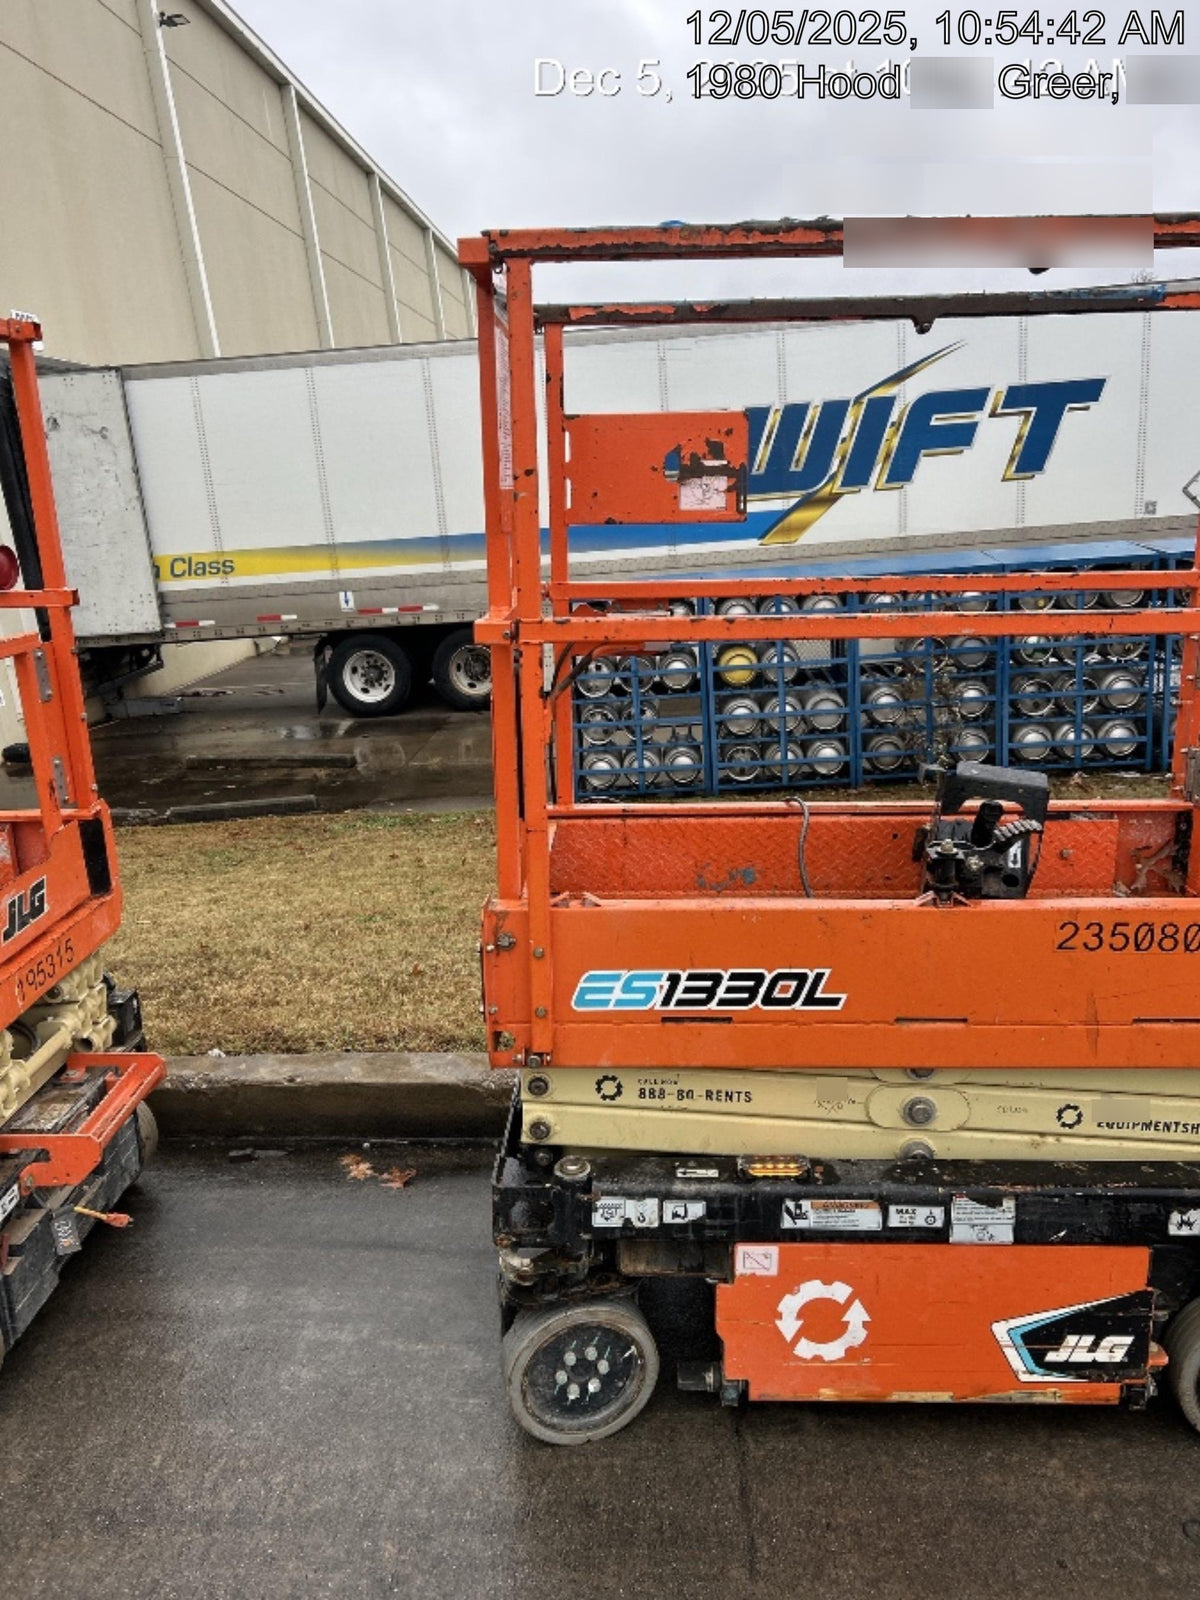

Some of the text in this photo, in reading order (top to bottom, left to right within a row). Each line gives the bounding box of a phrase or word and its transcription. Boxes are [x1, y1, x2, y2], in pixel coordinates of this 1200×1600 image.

[170, 557, 235, 578] Class
[2, 876, 47, 944] JLG
[572, 968, 848, 1011] ES1330L
[1043, 1334, 1136, 1363] JLG
